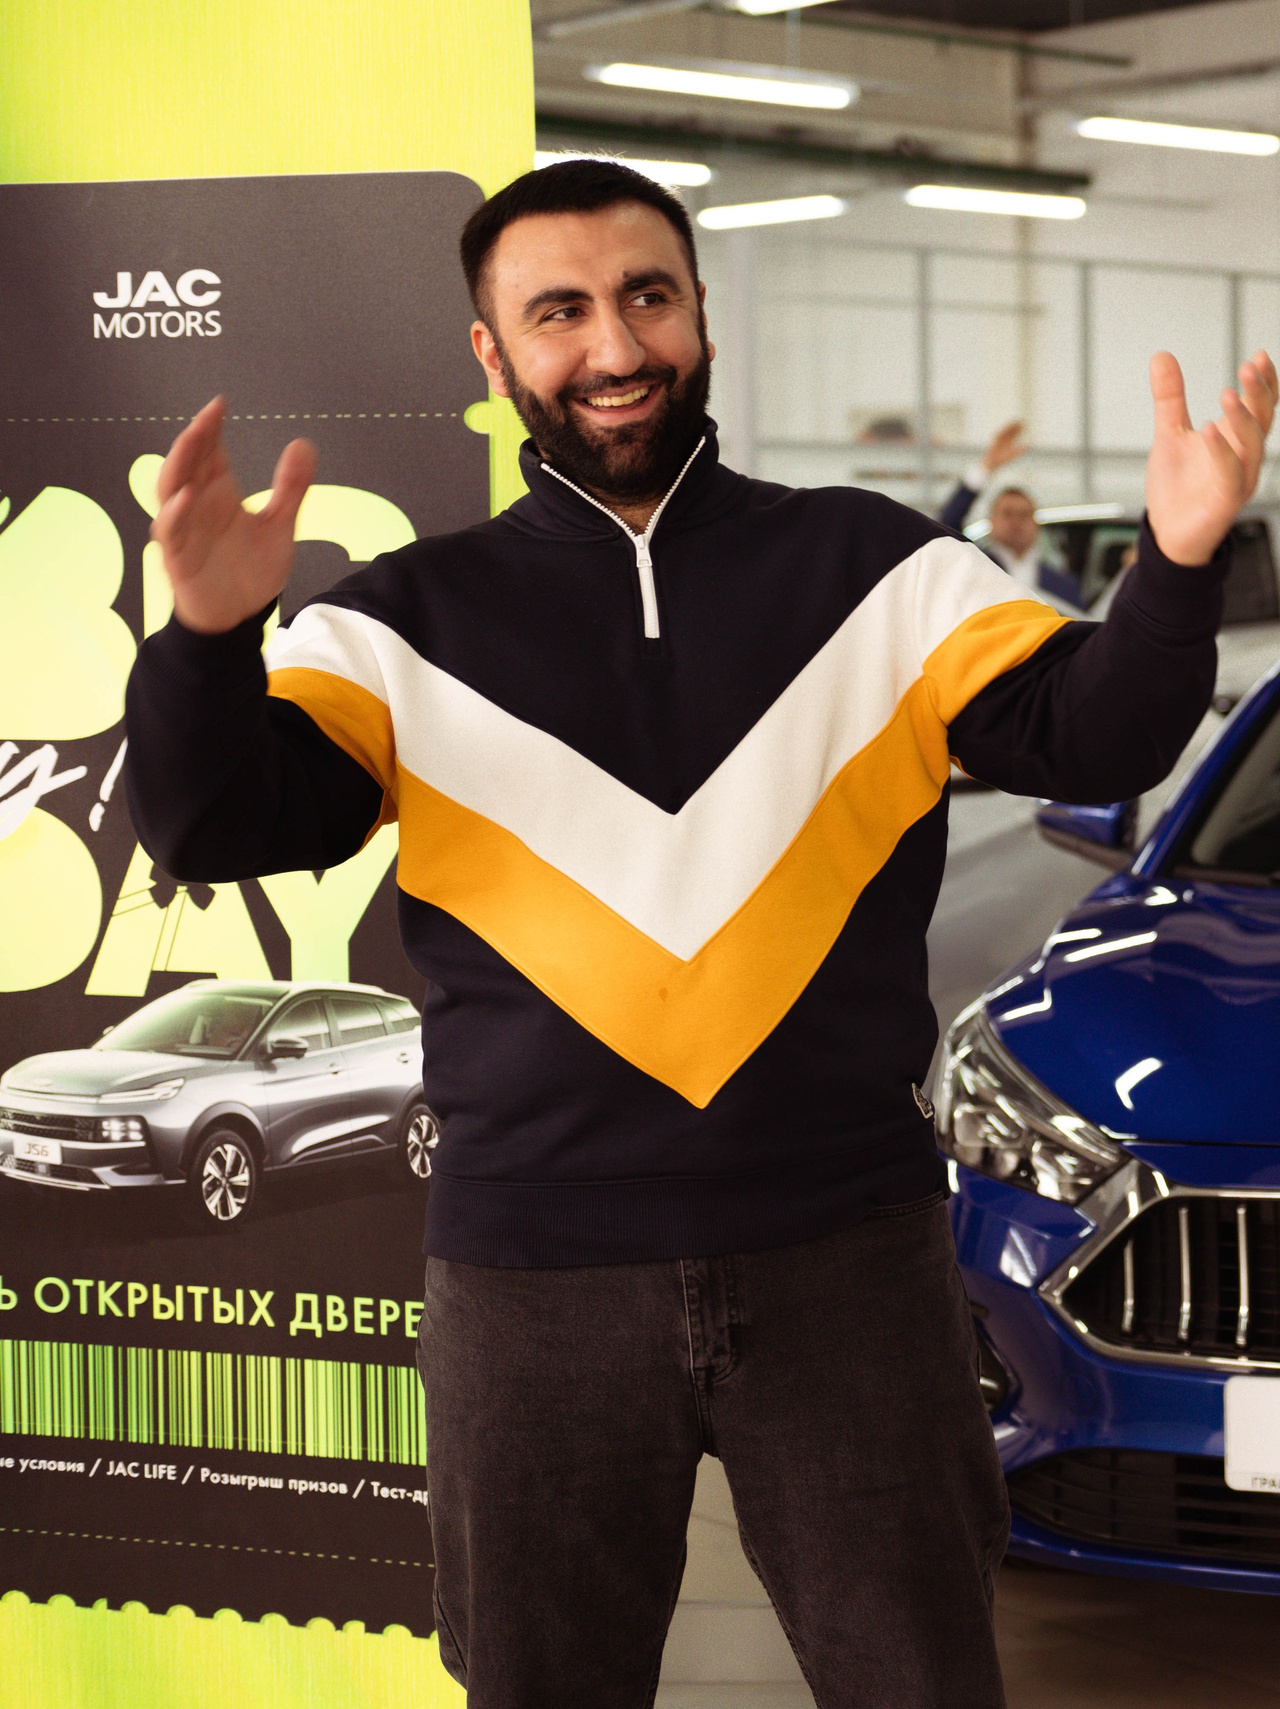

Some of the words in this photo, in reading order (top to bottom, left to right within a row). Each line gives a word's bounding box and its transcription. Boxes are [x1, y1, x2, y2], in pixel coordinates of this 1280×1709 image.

[93, 269, 222, 308] JAC
[93, 310, 222, 339] MOTORS
[24, 1142, 49, 1157] JS6
[33, 1276, 276, 1328] ОТКРЫТЫХ
[289, 1292, 425, 1338] ДВЕРЕ
[19, 1458, 85, 1474] условия
[106, 1460, 140, 1478] JAC
[144, 1463, 178, 1481] LIFE
[200, 1467, 284, 1491] Розыгрыш
[288, 1478, 348, 1495] призов
